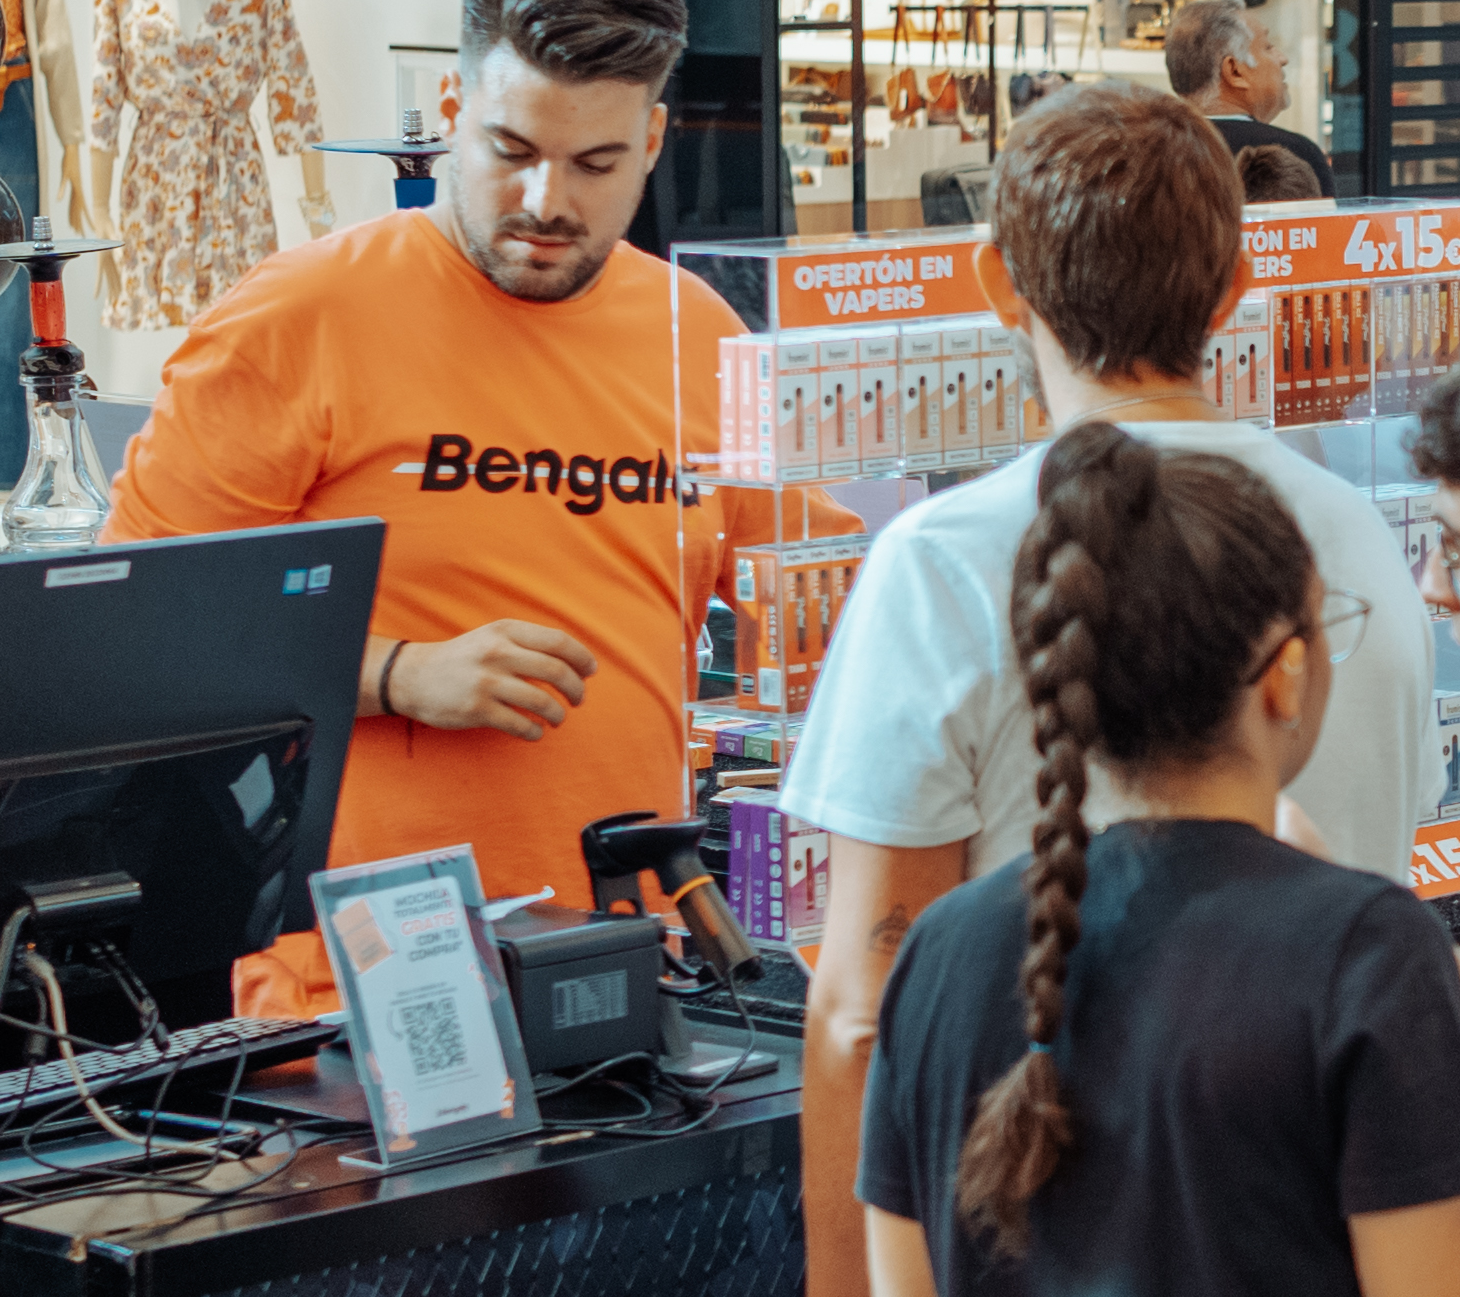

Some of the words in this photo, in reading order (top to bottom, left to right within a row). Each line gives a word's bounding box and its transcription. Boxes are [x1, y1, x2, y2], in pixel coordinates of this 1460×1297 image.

[1289, 227, 1317, 250] EN
[794, 253, 913, 291] OFERTÓN
[919, 255, 954, 280] EN
[824, 285, 926, 315] VAPERS
[420, 433, 702, 516] Bengala
[401, 911, 456, 936] GRATIS
